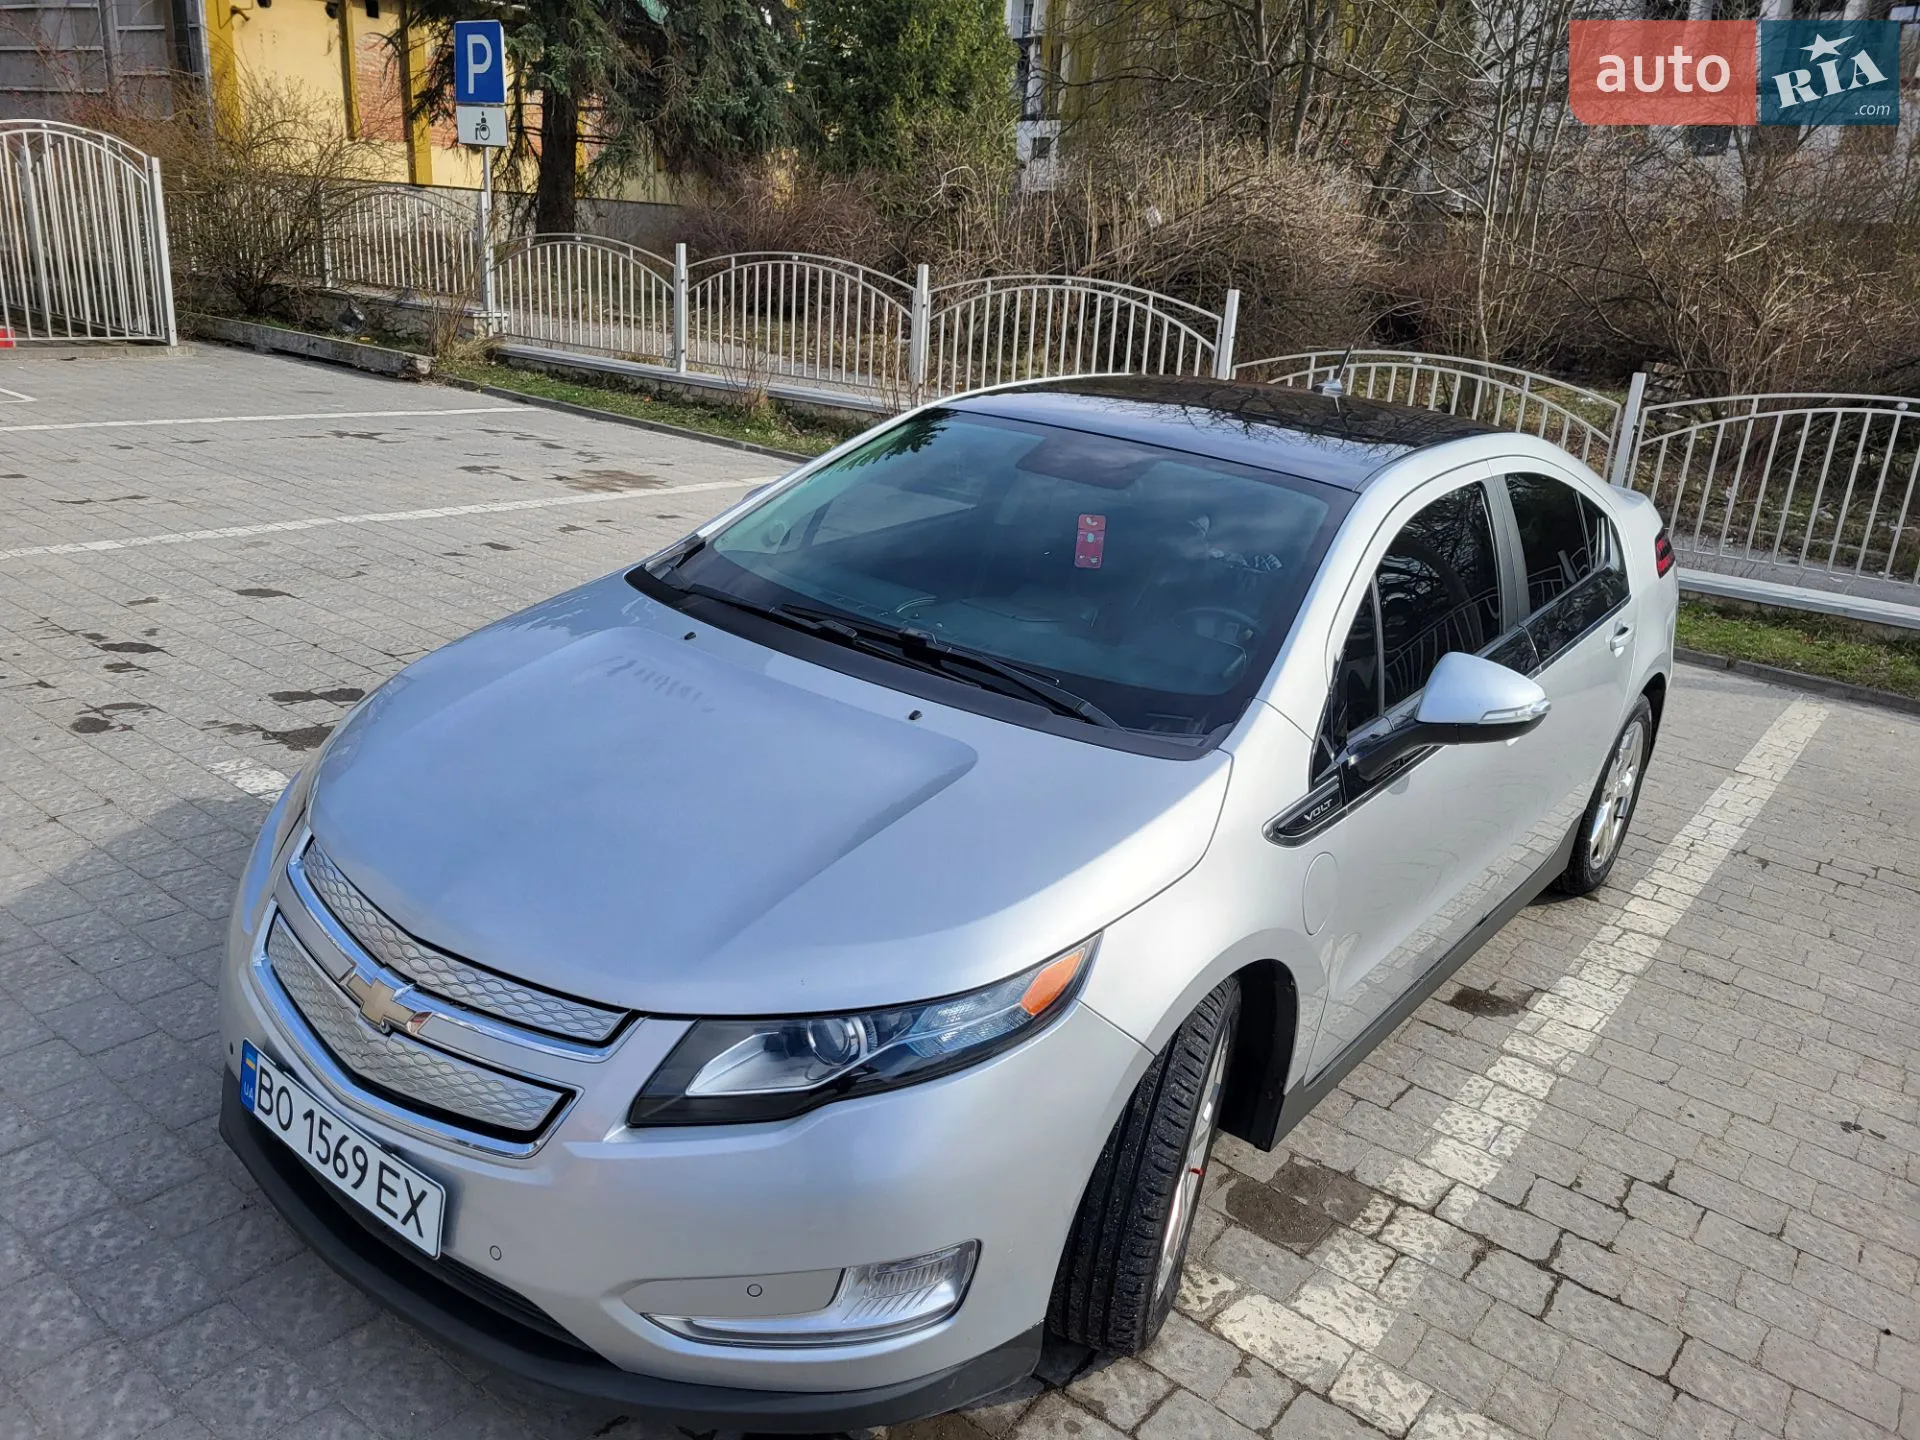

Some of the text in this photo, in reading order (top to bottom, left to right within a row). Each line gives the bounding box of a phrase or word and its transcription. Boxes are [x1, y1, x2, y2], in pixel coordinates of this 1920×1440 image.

[466, 33, 493, 95] P
[1303, 798, 1333, 821] VOLT
[243, 1081, 254, 1100] UA
[256, 1065, 428, 1239] BO 1569 EX
